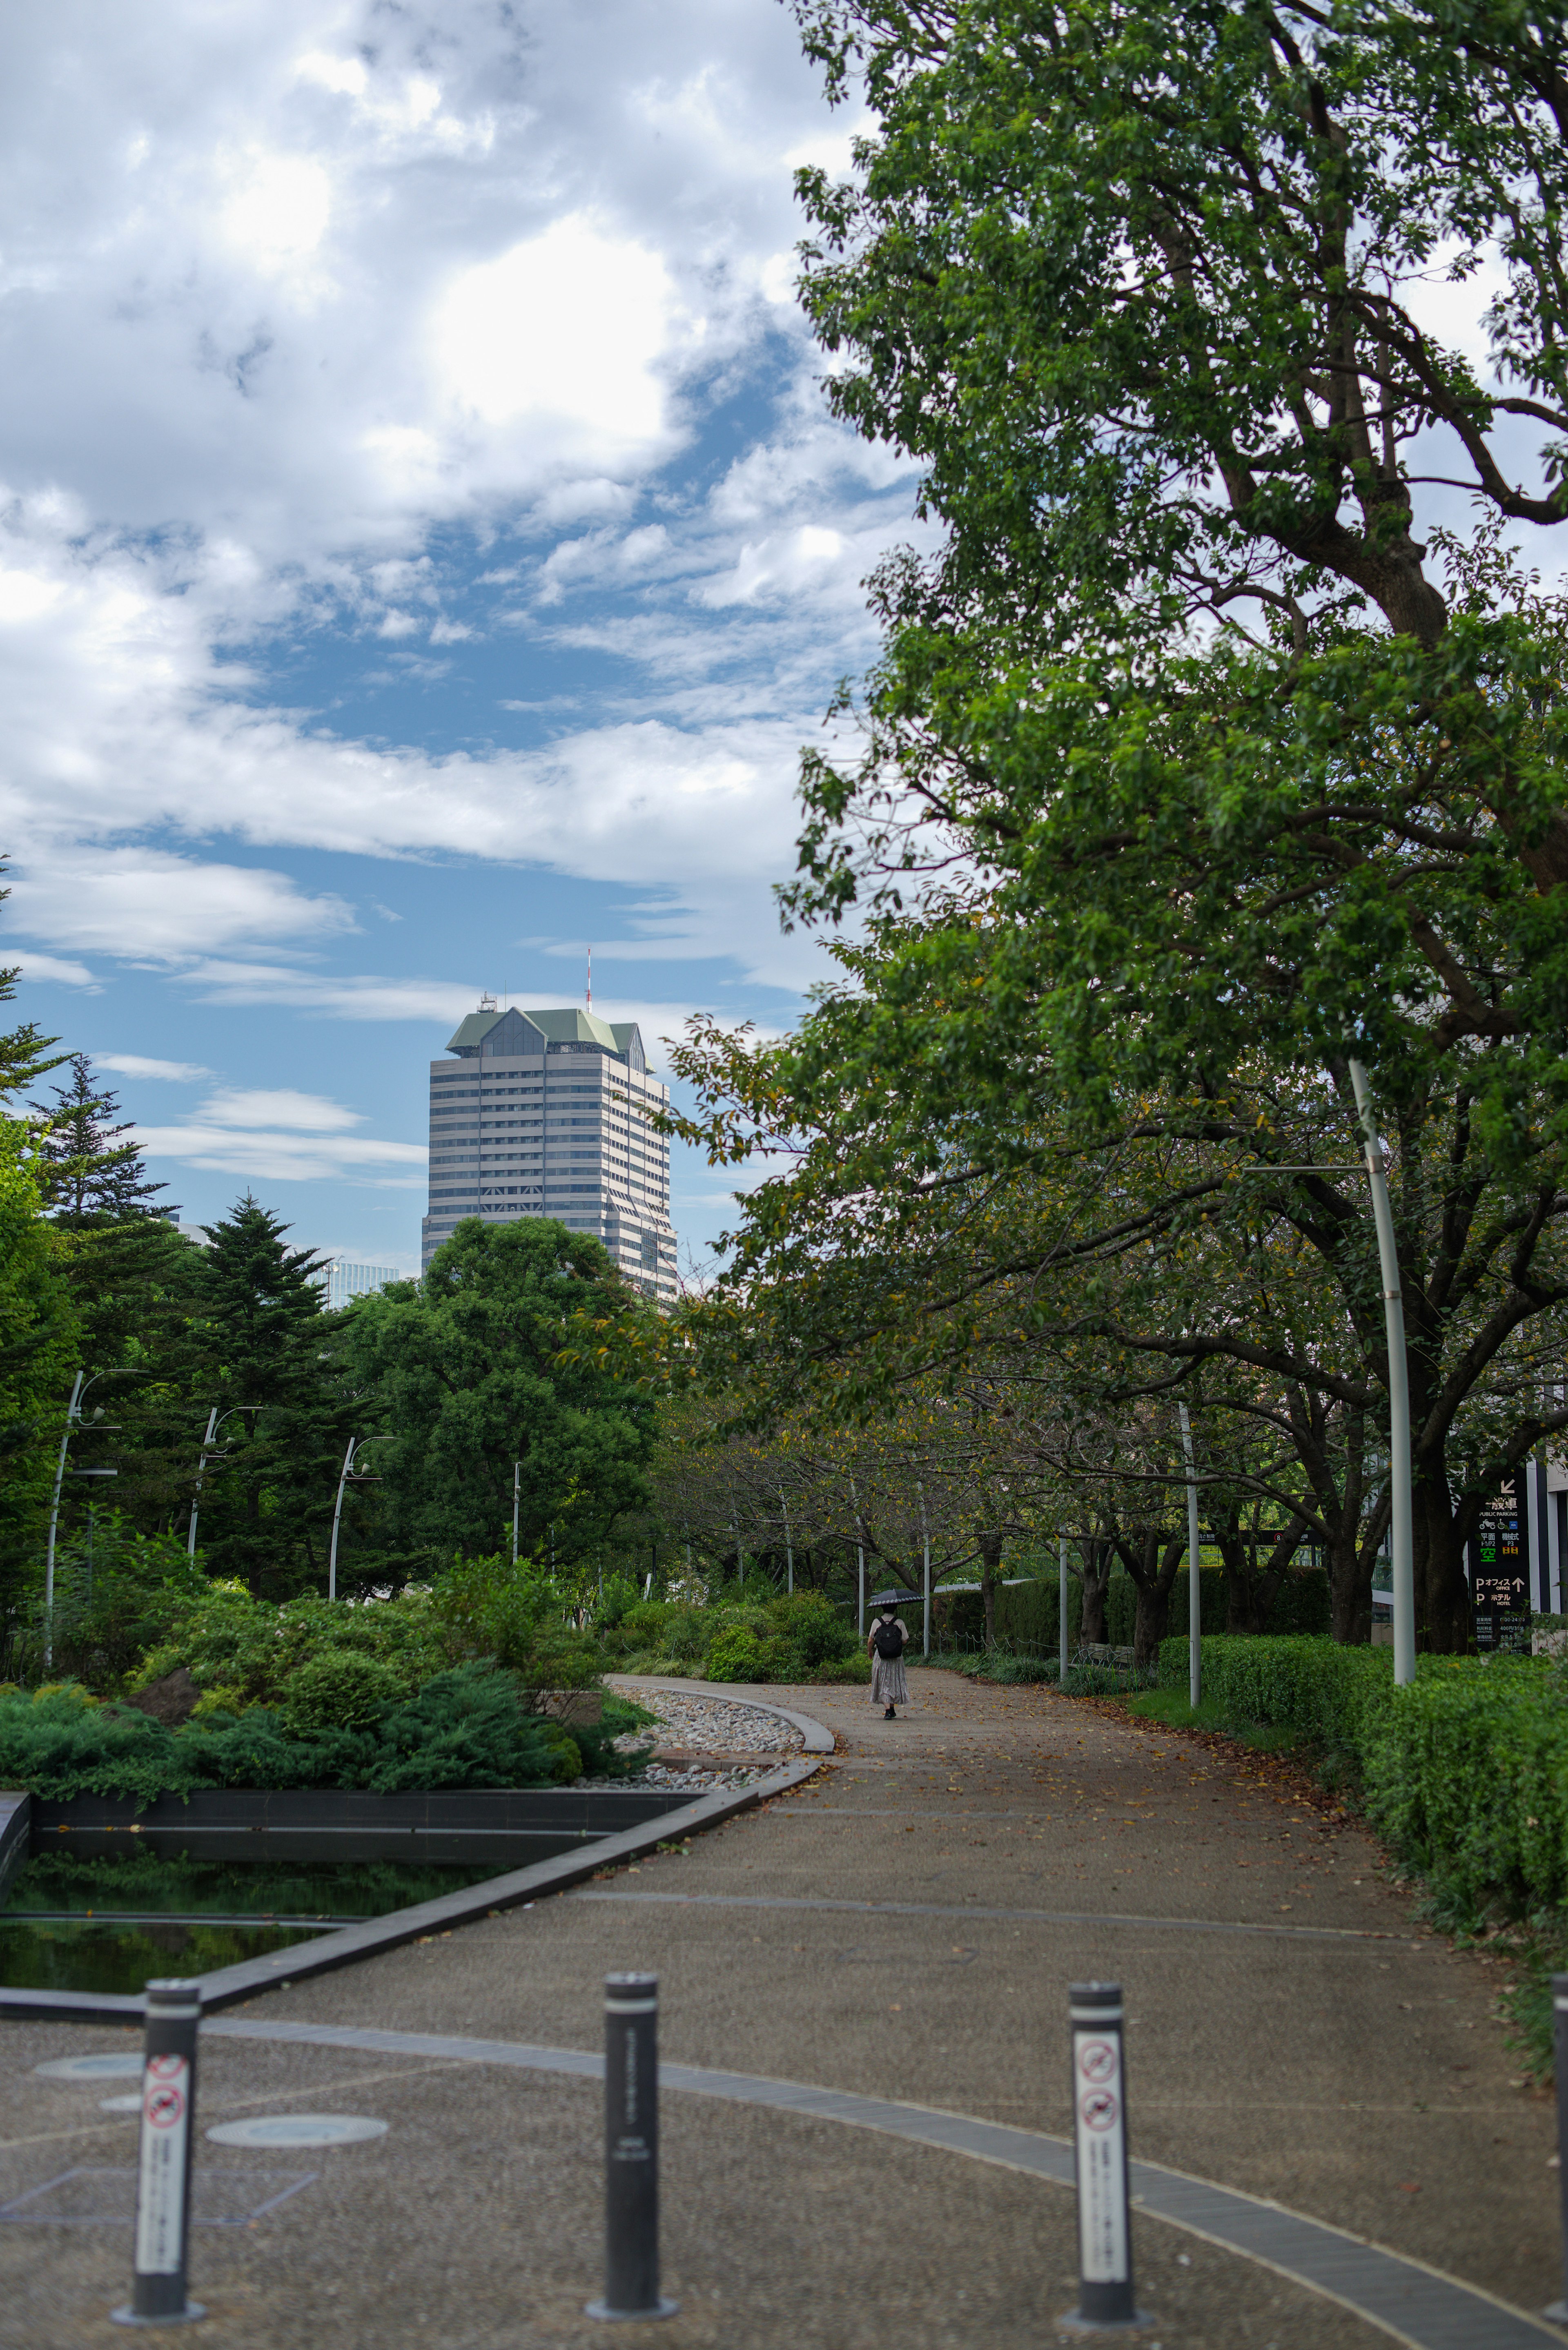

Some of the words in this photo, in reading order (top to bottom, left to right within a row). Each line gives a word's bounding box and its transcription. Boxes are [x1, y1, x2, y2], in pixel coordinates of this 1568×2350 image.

[1485, 1497, 1517, 1510] 一般車
[1480, 1547, 1496, 1562] 空
